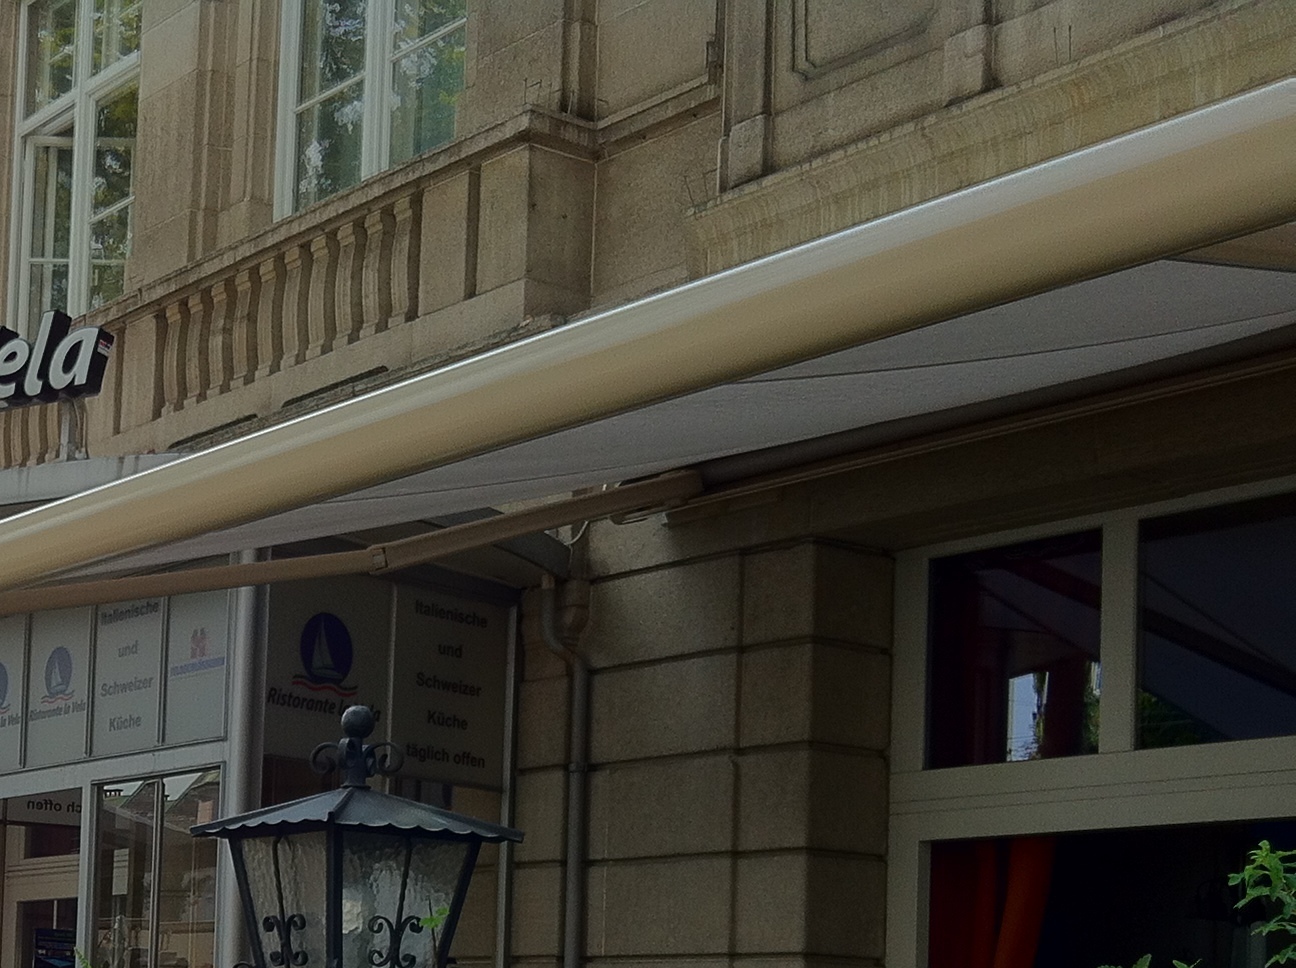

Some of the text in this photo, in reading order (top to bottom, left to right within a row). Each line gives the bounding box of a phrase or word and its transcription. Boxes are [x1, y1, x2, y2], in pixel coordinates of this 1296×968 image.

[414, 599, 489, 629] Italienische
[117, 639, 139, 659] und
[437, 642, 464, 660] und
[100, 674, 155, 698] Schweizer
[415, 672, 483, 698] Schweizer
[267, 686, 336, 716] Ristorante
[109, 711, 143, 732] Küche
[426, 709, 469, 731] Küche
[406, 742, 486, 769] täglich offen
